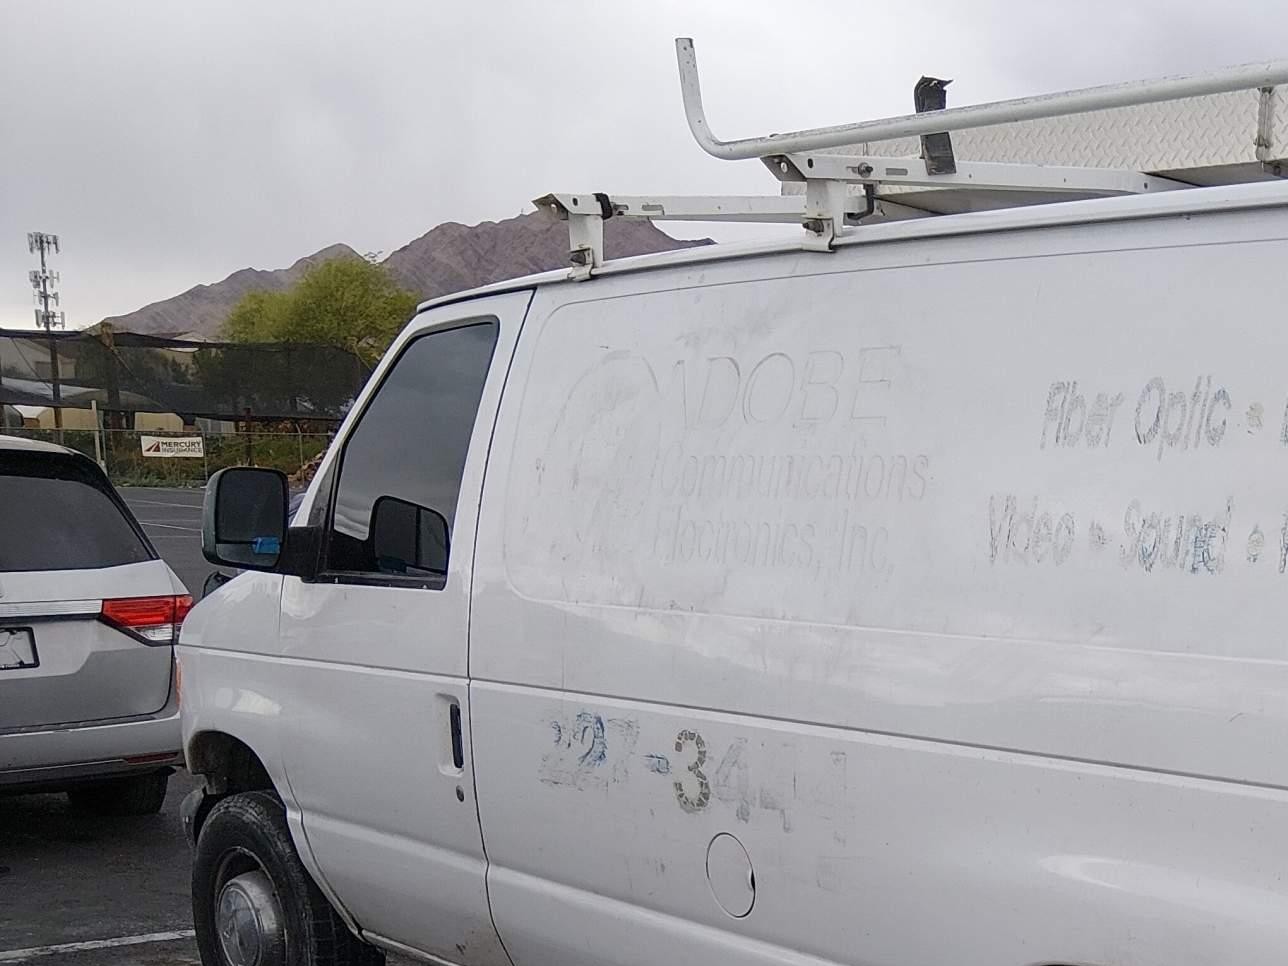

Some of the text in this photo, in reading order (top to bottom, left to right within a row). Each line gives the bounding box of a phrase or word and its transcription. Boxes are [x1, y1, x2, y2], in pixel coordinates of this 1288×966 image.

[1039, 379, 1125, 451] Fiber
[1133, 375, 1233, 462] Optic
[986, 493, 1077, 568] Video
[1118, 495, 1235, 576] Sound
